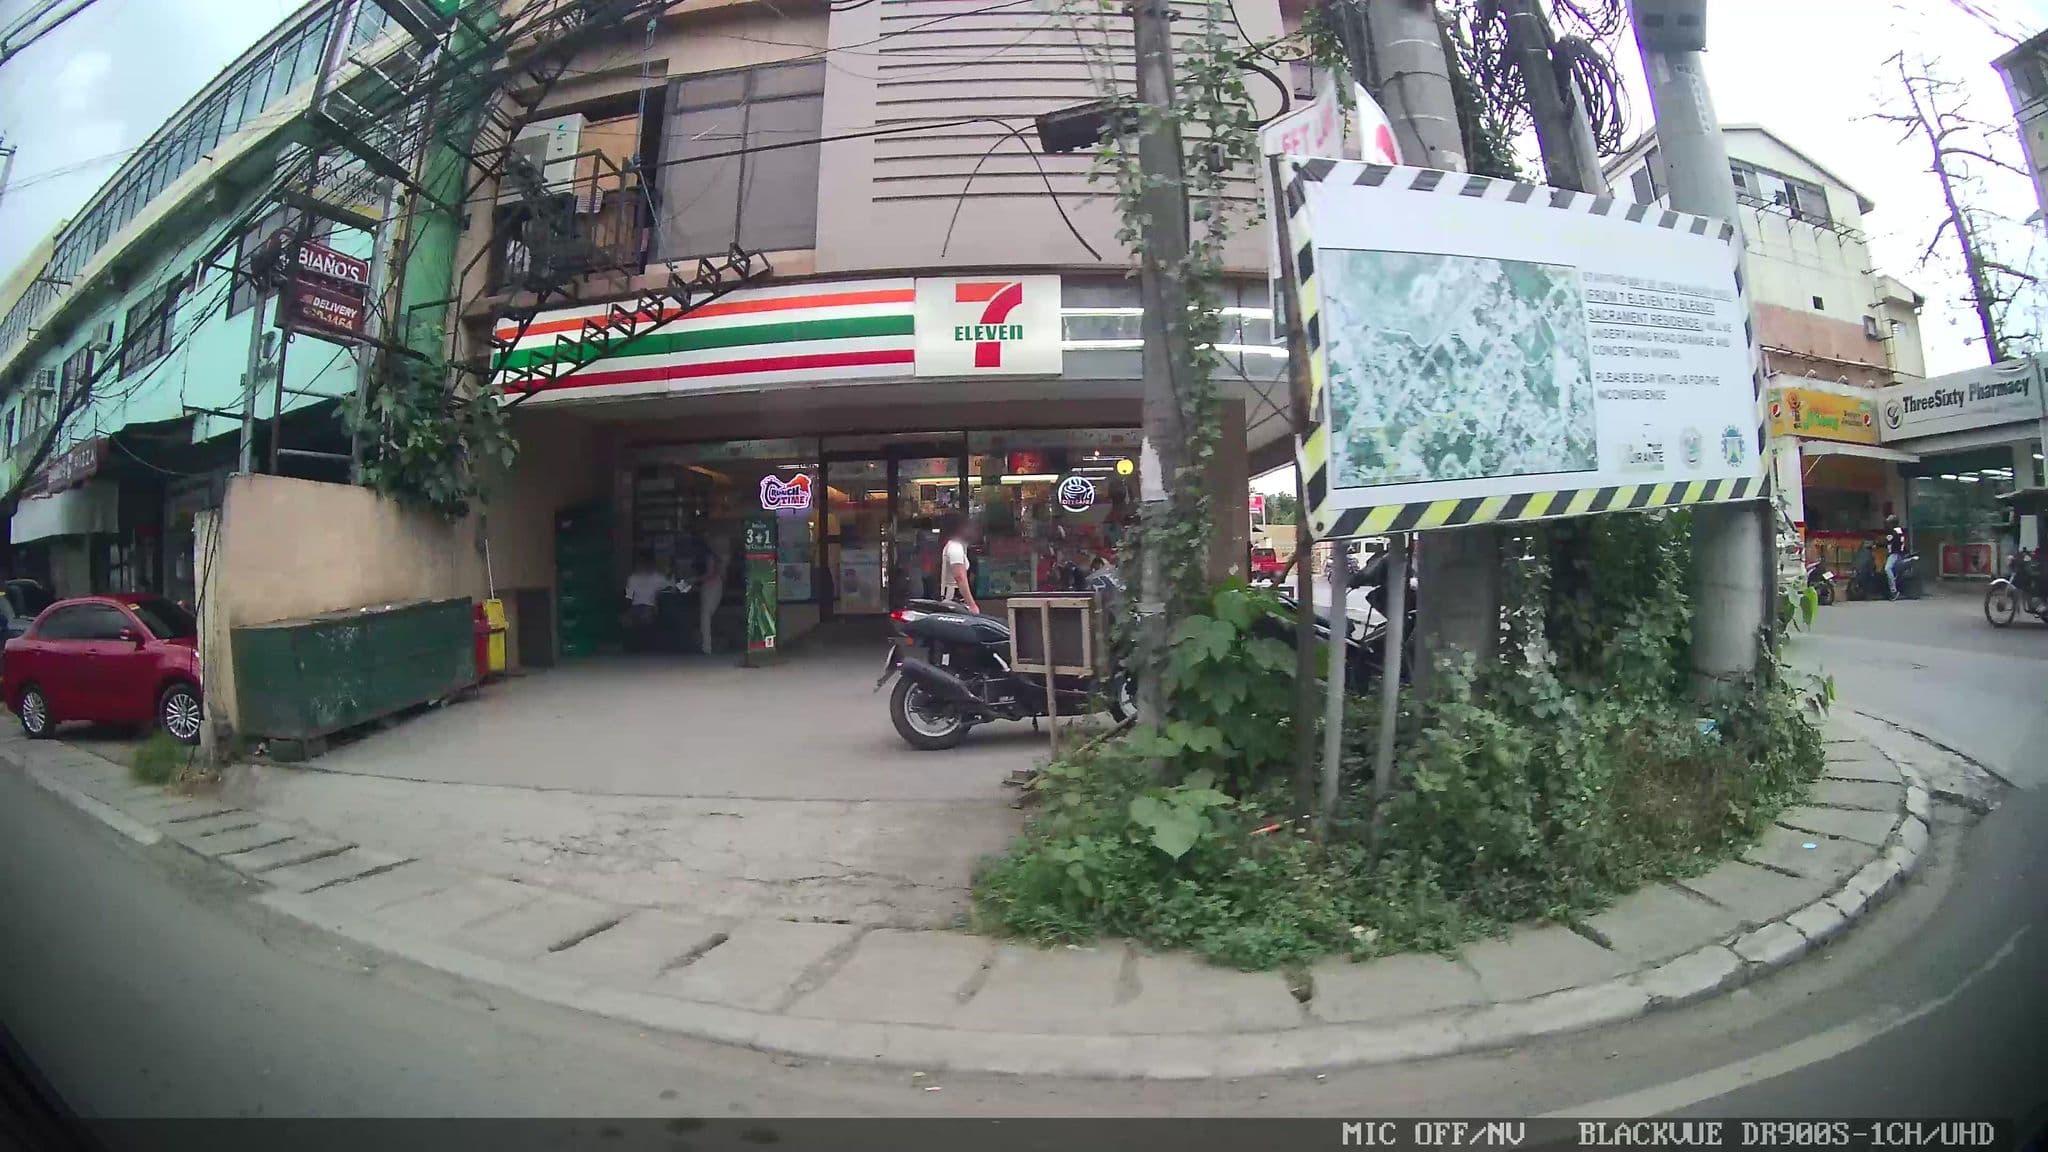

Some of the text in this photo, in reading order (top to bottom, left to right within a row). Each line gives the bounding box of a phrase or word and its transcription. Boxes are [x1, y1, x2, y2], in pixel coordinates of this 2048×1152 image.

[299, 247, 360, 281] BIAÑO'S
[1627, 292, 1664, 307] ELEVEN
[313, 296, 358, 319] DELIVERY
[1588, 308, 1648, 323] SACRAMENT
[1595, 371, 1631, 383] PLEASE
[1632, 372, 1656, 383] BEAR
[1903, 376, 2031, 414] ThreeSixty Pharmacy
[780, 496, 805, 504] TIME
